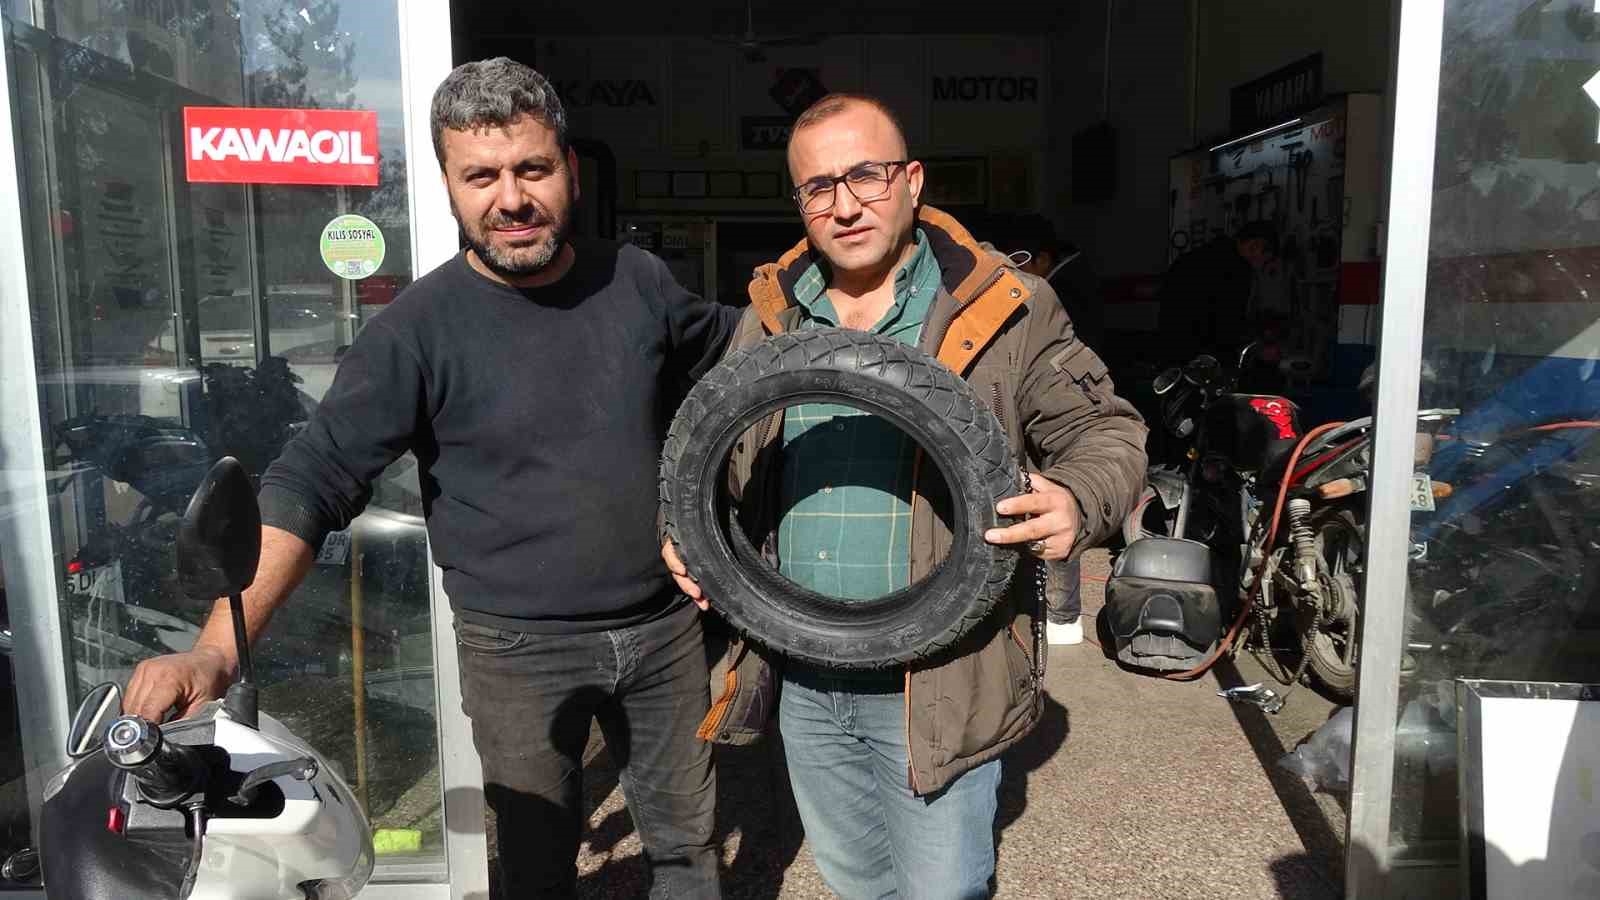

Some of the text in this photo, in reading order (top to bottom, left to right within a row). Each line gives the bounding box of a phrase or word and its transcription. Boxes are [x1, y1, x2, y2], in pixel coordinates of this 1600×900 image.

[932, 76, 1039, 101] MOTOR
[190, 126, 376, 165] KAWAOIL
[348, 228, 376, 240] SOSYAL
